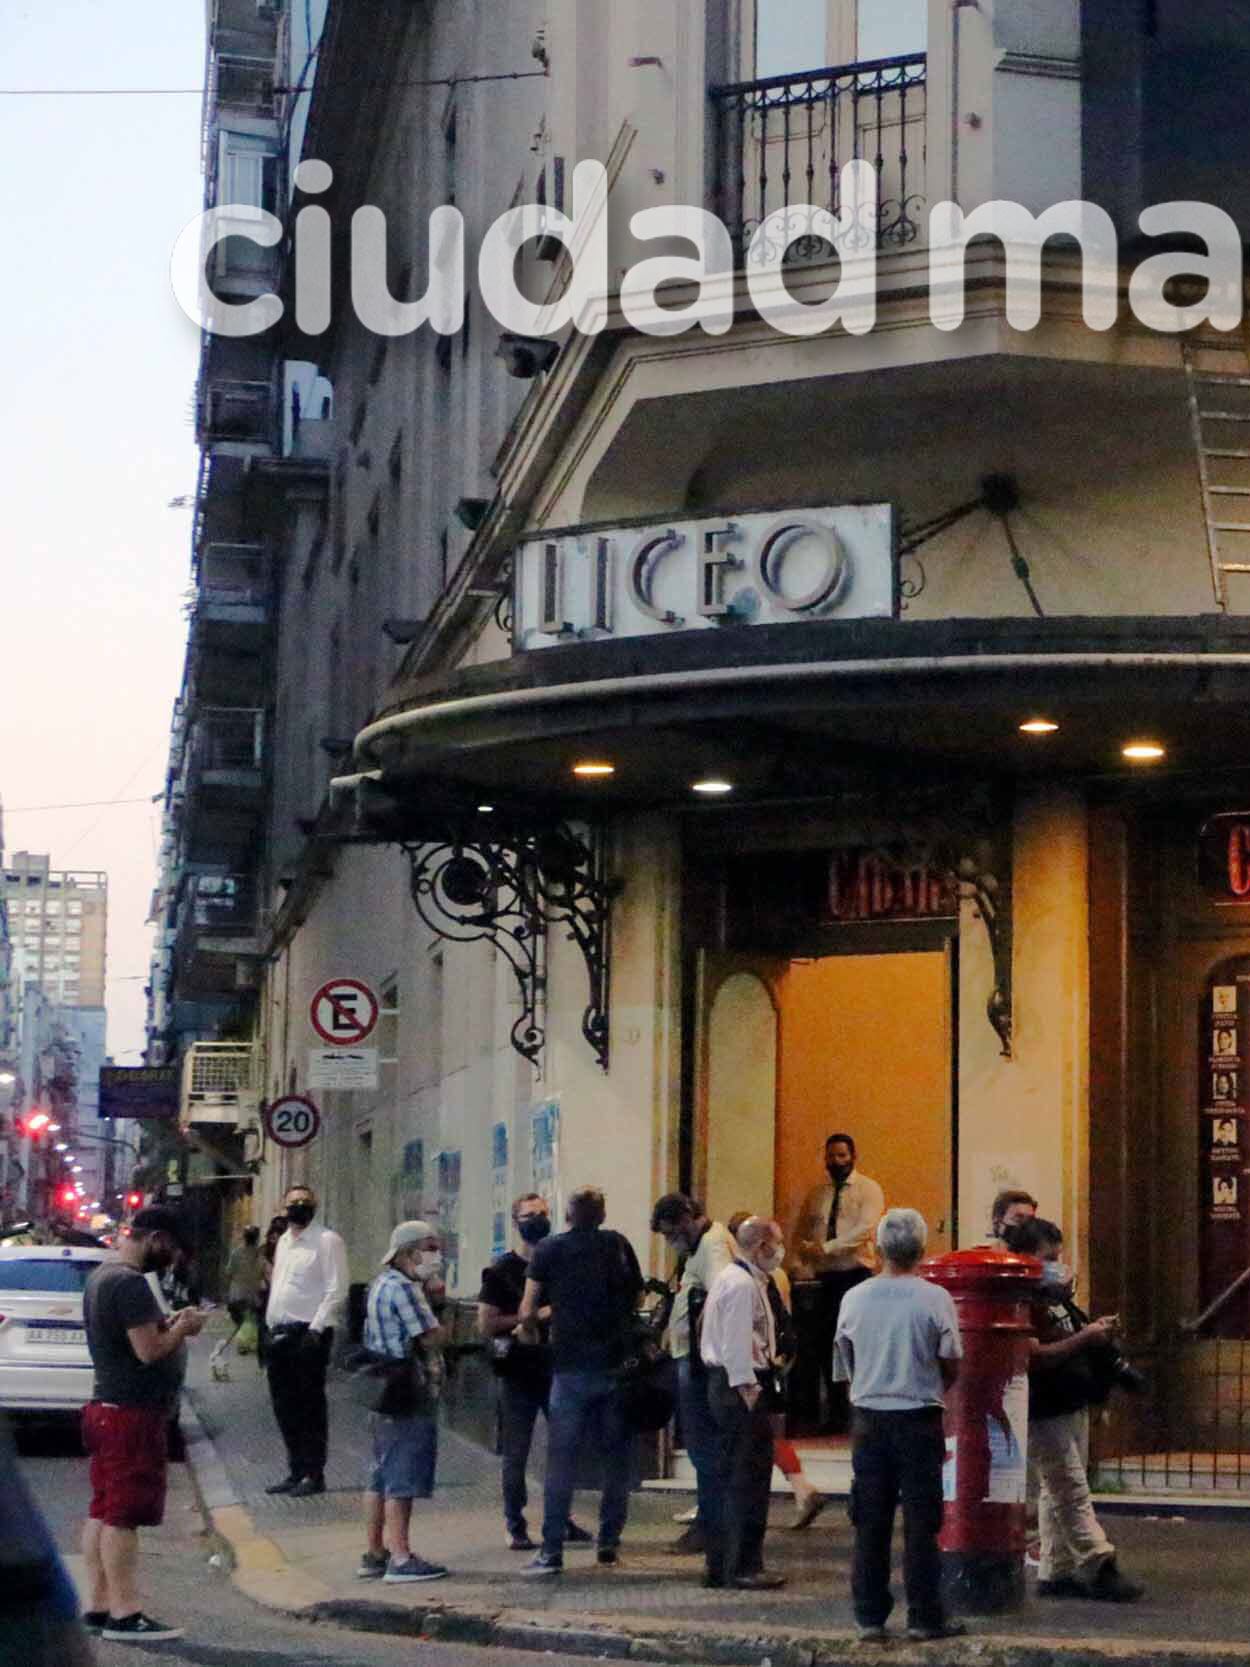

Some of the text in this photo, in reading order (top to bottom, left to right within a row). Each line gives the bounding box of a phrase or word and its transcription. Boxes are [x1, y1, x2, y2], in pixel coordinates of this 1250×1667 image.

[538, 517, 853, 638] LICEO
[332, 993, 358, 1031] E
[277, 1110, 310, 1132] 20
